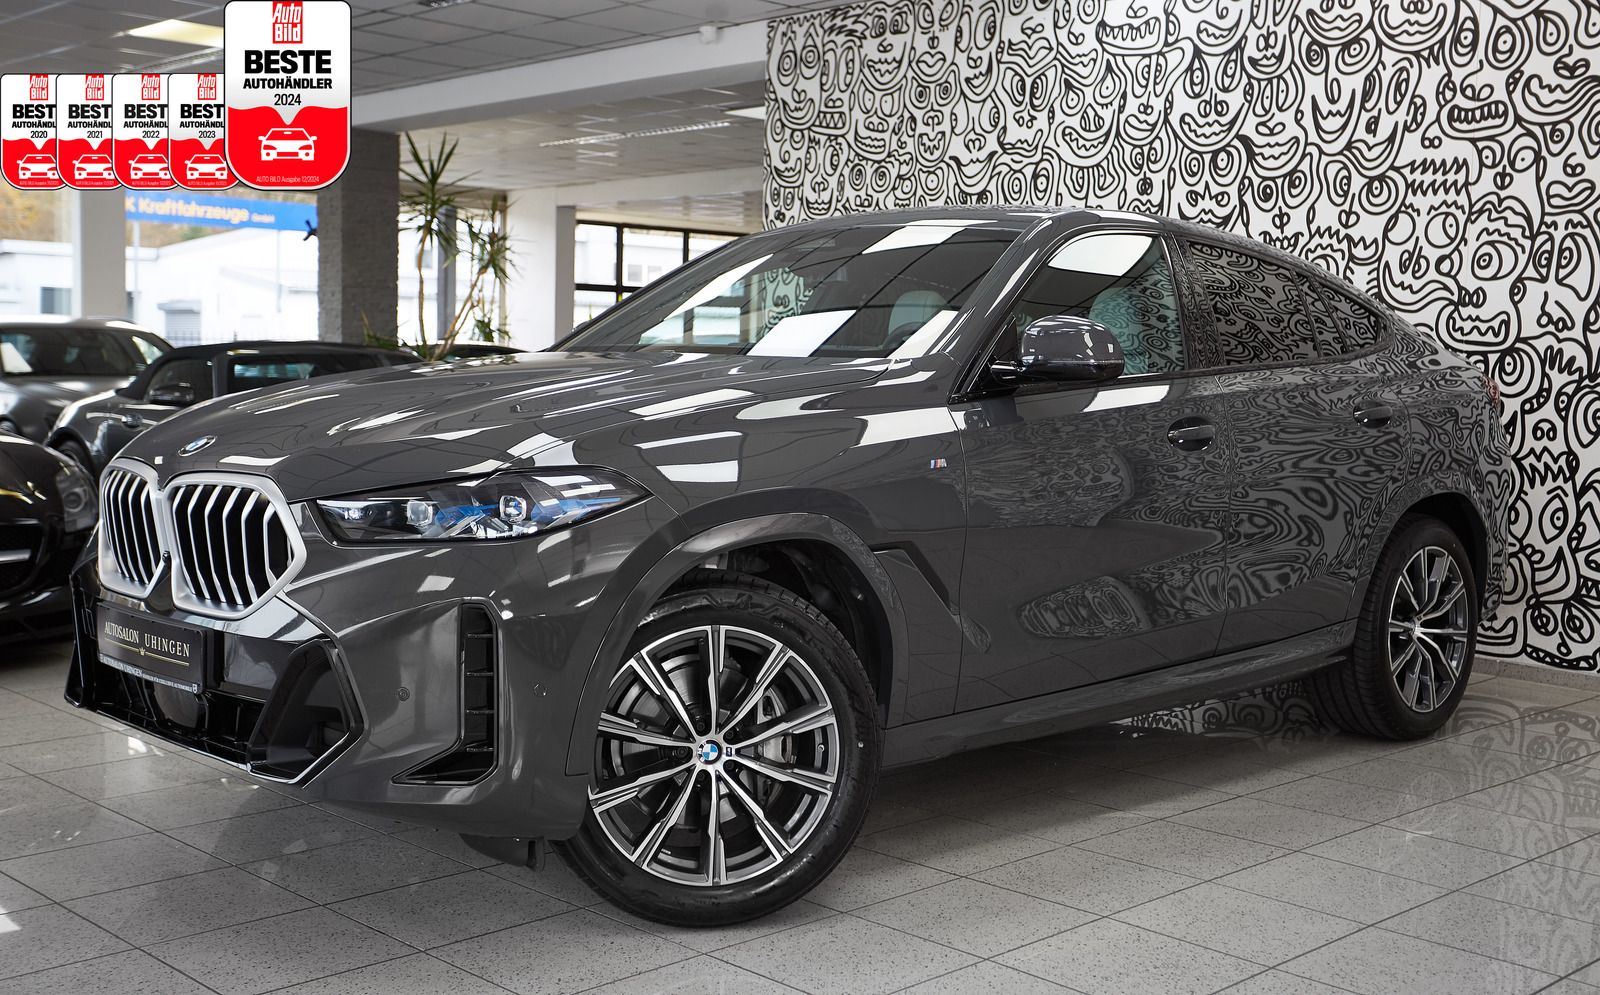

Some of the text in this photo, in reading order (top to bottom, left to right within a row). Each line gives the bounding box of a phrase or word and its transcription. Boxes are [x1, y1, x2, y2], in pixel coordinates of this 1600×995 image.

[139, 197, 249, 224] Kraftfahrzeuge
[104, 621, 190, 657] AUTOSALON UHINGEN
